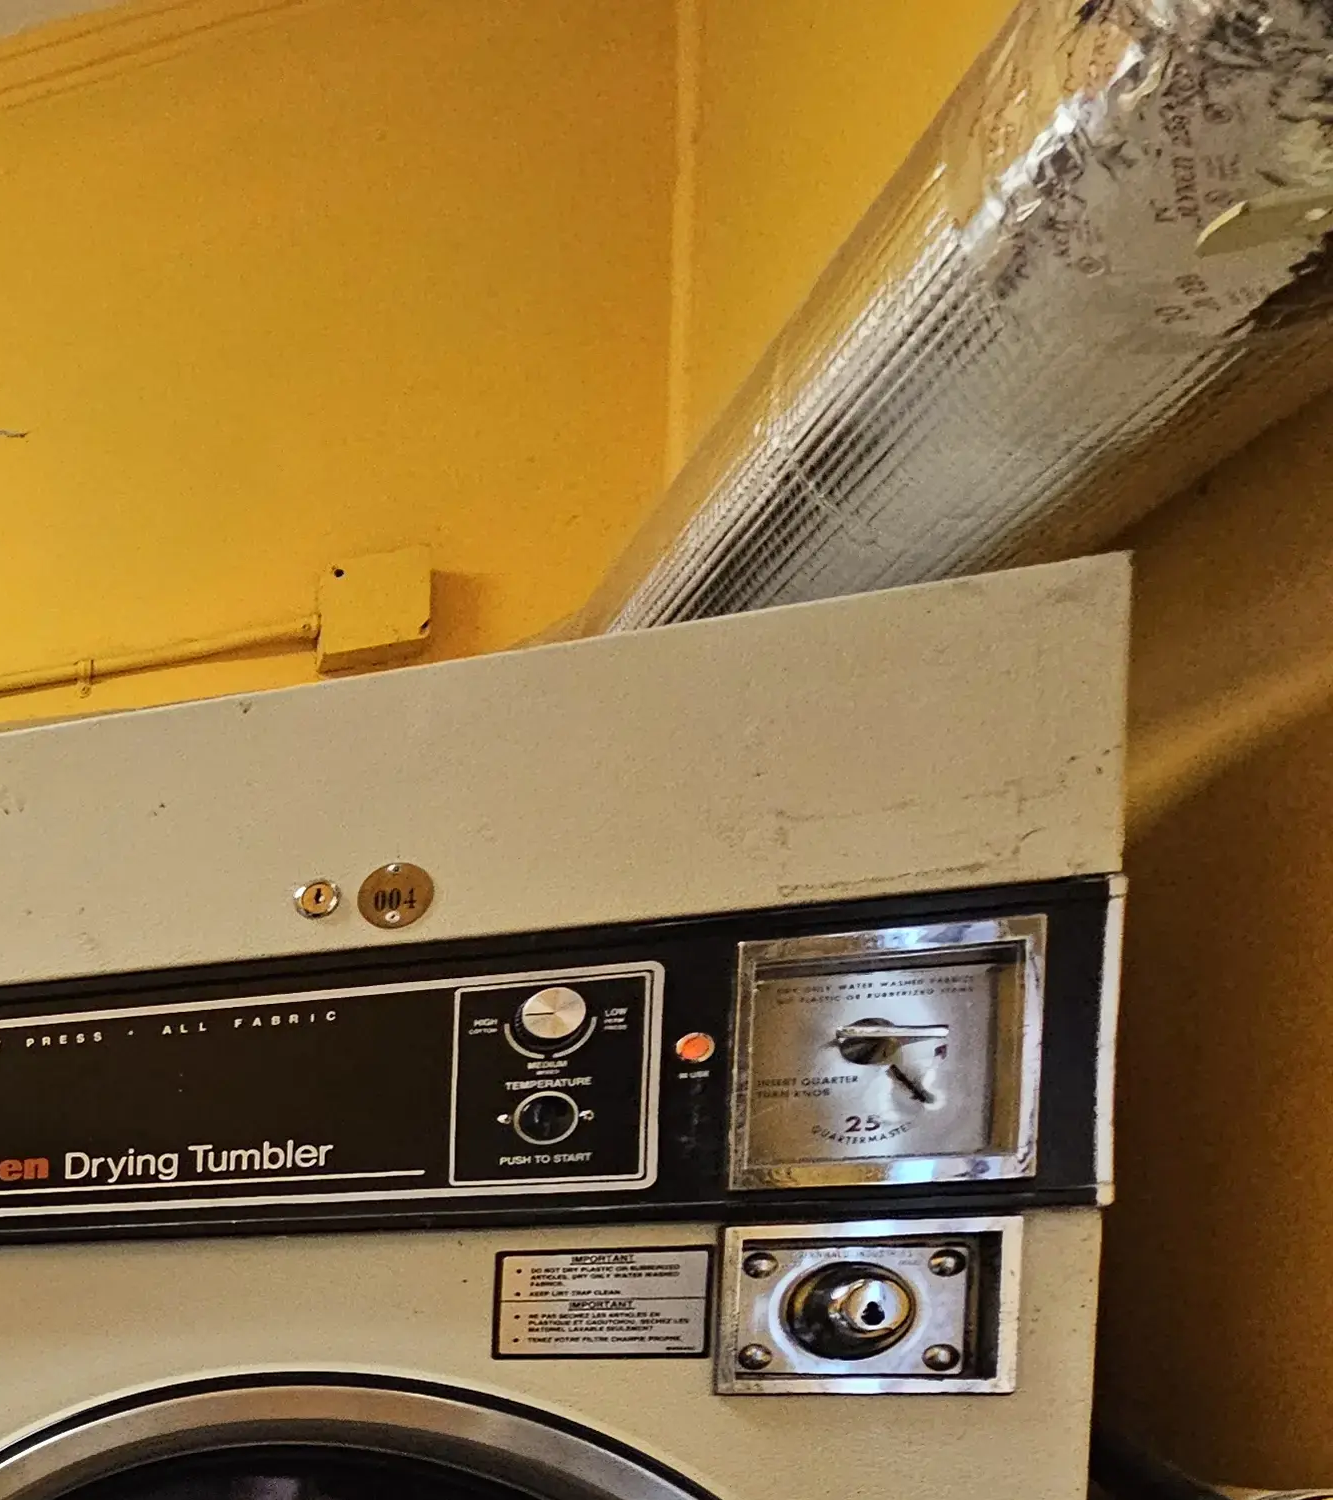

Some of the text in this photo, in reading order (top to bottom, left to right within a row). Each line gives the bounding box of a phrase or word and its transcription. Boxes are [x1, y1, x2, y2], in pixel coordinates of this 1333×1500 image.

[374, 887, 417, 912] 004
[838, 981, 873, 990] WATER
[880, 978, 924, 988] WASHED
[604, 1007, 628, 1017] LOW
[25, 1032, 103, 1048] PRESS
[161, 1021, 207, 1036] ALL
[233, 1010, 337, 1029] FABRIC
[505, 1076, 593, 1091] TEMPERATURE
[801, 1075, 859, 1086] QUARTER
[844, 1115, 881, 1133] 25
[64, 1147, 179, 1184] Drying
[187, 1139, 334, 1174] Tumbler
[499, 1152, 593, 1166] PUSH TO START
[571, 1255, 635, 1263] IMPORTANT
[570, 1301, 635, 1309] IMPORTANT
